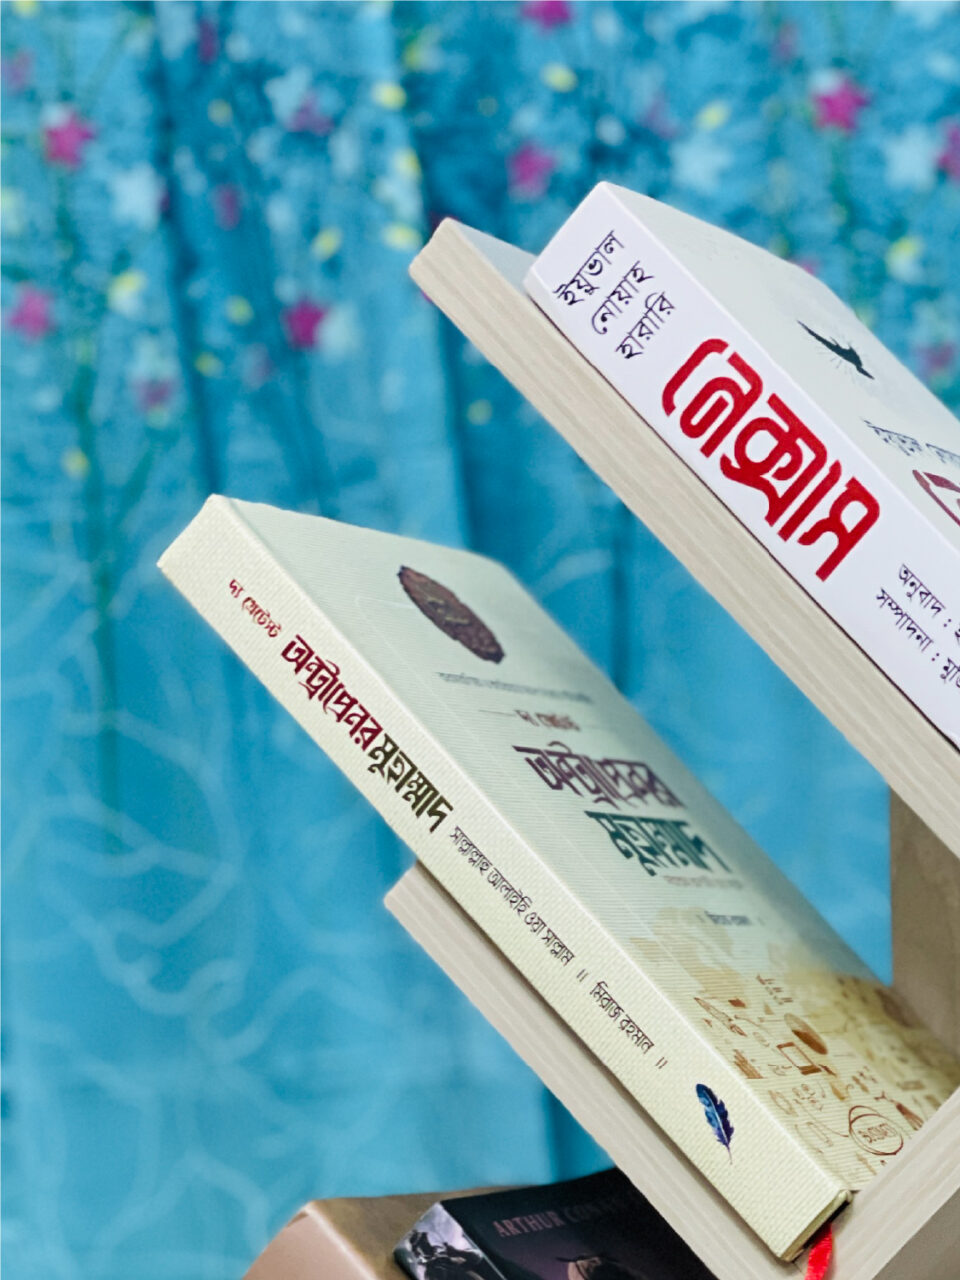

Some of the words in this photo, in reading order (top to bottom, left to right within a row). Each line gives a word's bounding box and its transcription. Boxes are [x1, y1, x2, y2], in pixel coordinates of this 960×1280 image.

[591, 260, 654, 335] নোয়াহ
[615, 290, 676, 360] হারারি
[662, 338, 881, 582] নেক্সাস
[876, 588, 935, 653] সম্পাদনা
[898, 563, 946, 619] অনুবাদ
[589, 980, 626, 1023] মিরাজ
[619, 1013, 655, 1055] রহমান
[492, 1209, 565, 1238] ARTHUR
